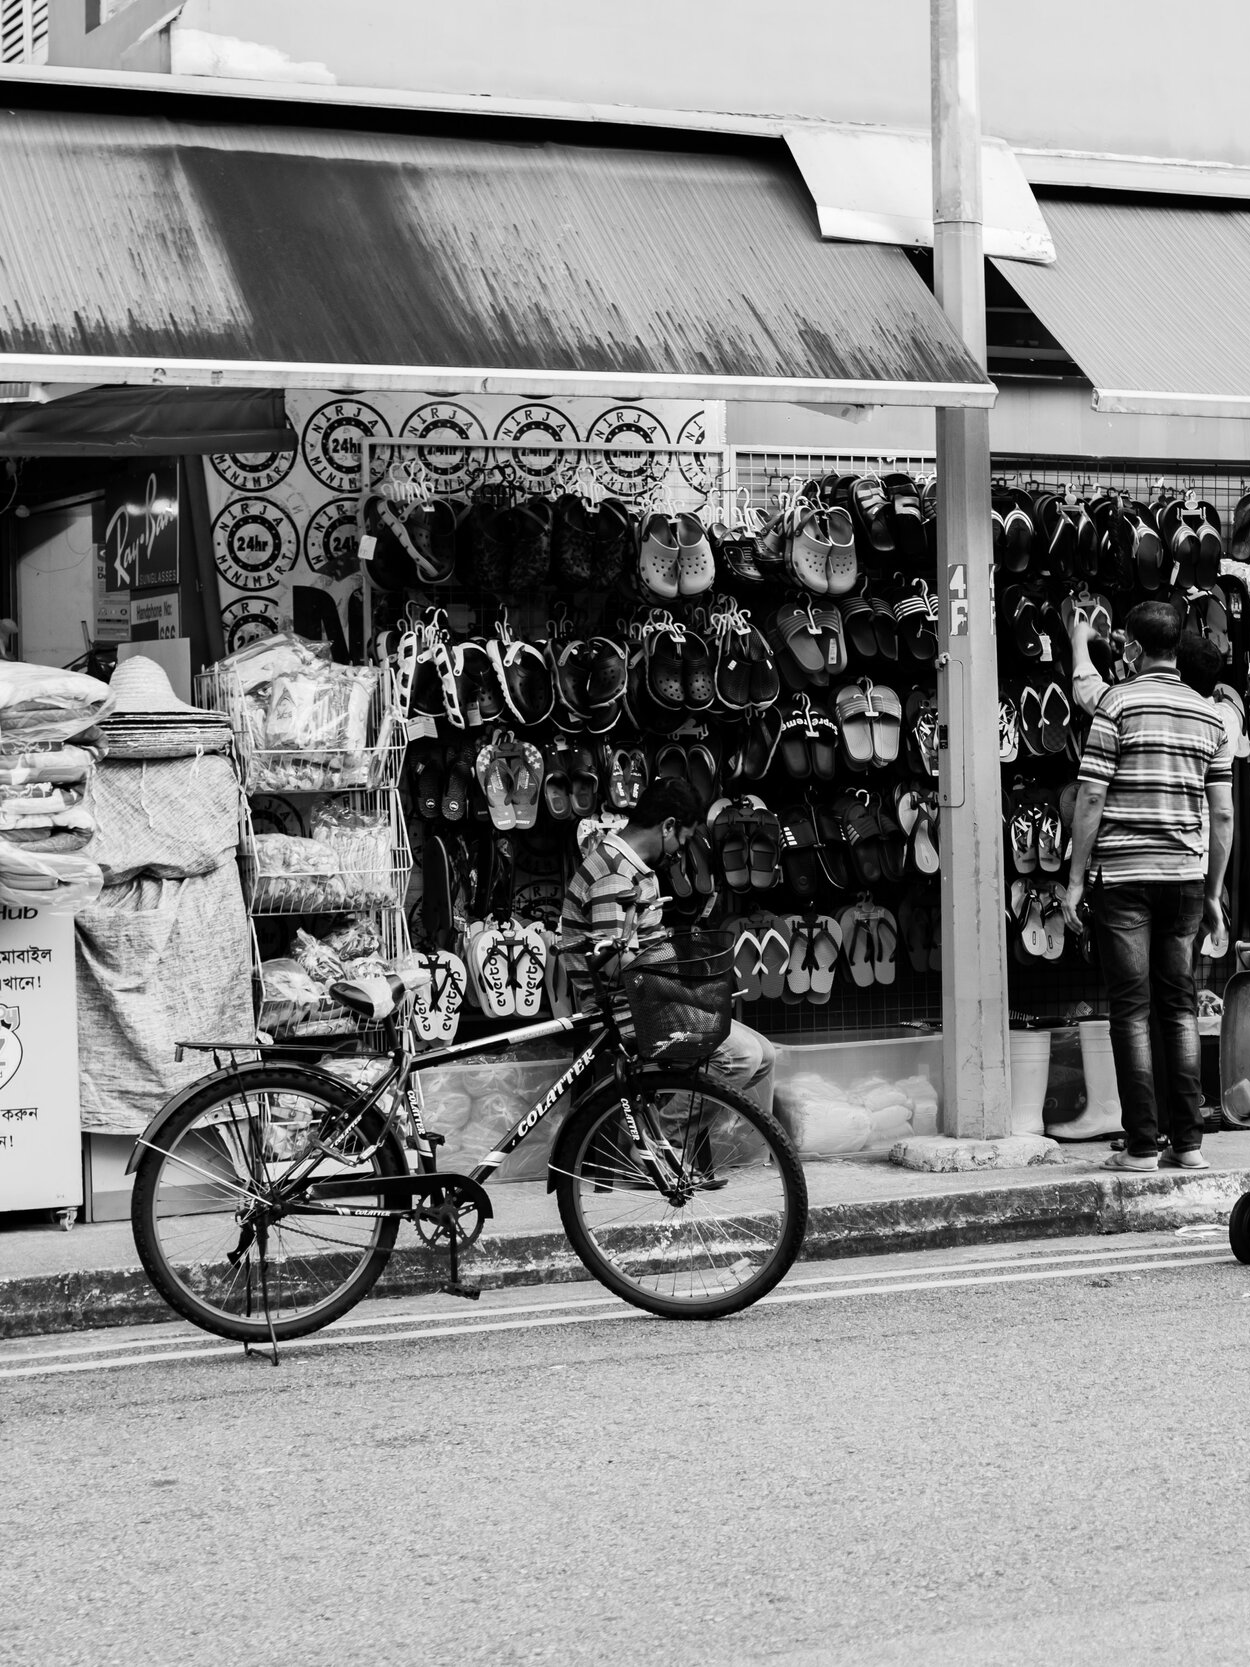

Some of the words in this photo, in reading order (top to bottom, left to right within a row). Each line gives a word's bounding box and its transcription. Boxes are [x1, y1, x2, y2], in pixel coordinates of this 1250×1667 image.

[311, 405, 379, 434] NIRJA
[407, 407, 474, 437] NIRJA
[502, 410, 567, 438] NIRJA
[594, 412, 658, 440] NIRJA
[215, 454, 289, 488] MINIMART
[310, 455, 385, 489] MINIMRT
[219, 502, 284, 532] NIRJA
[237, 535, 268, 552] 24hr
[217, 553, 293, 587] MINIMART
[486, 947, 507, 1007] evertop
[524, 945, 544, 1007] evertop
[517, 1048, 595, 1137] COLATTER
[0, 1107, 39, 1123] করুন
[406, 1089, 426, 1135] COLATTER
[620, 1097, 640, 1142] COLATTER
